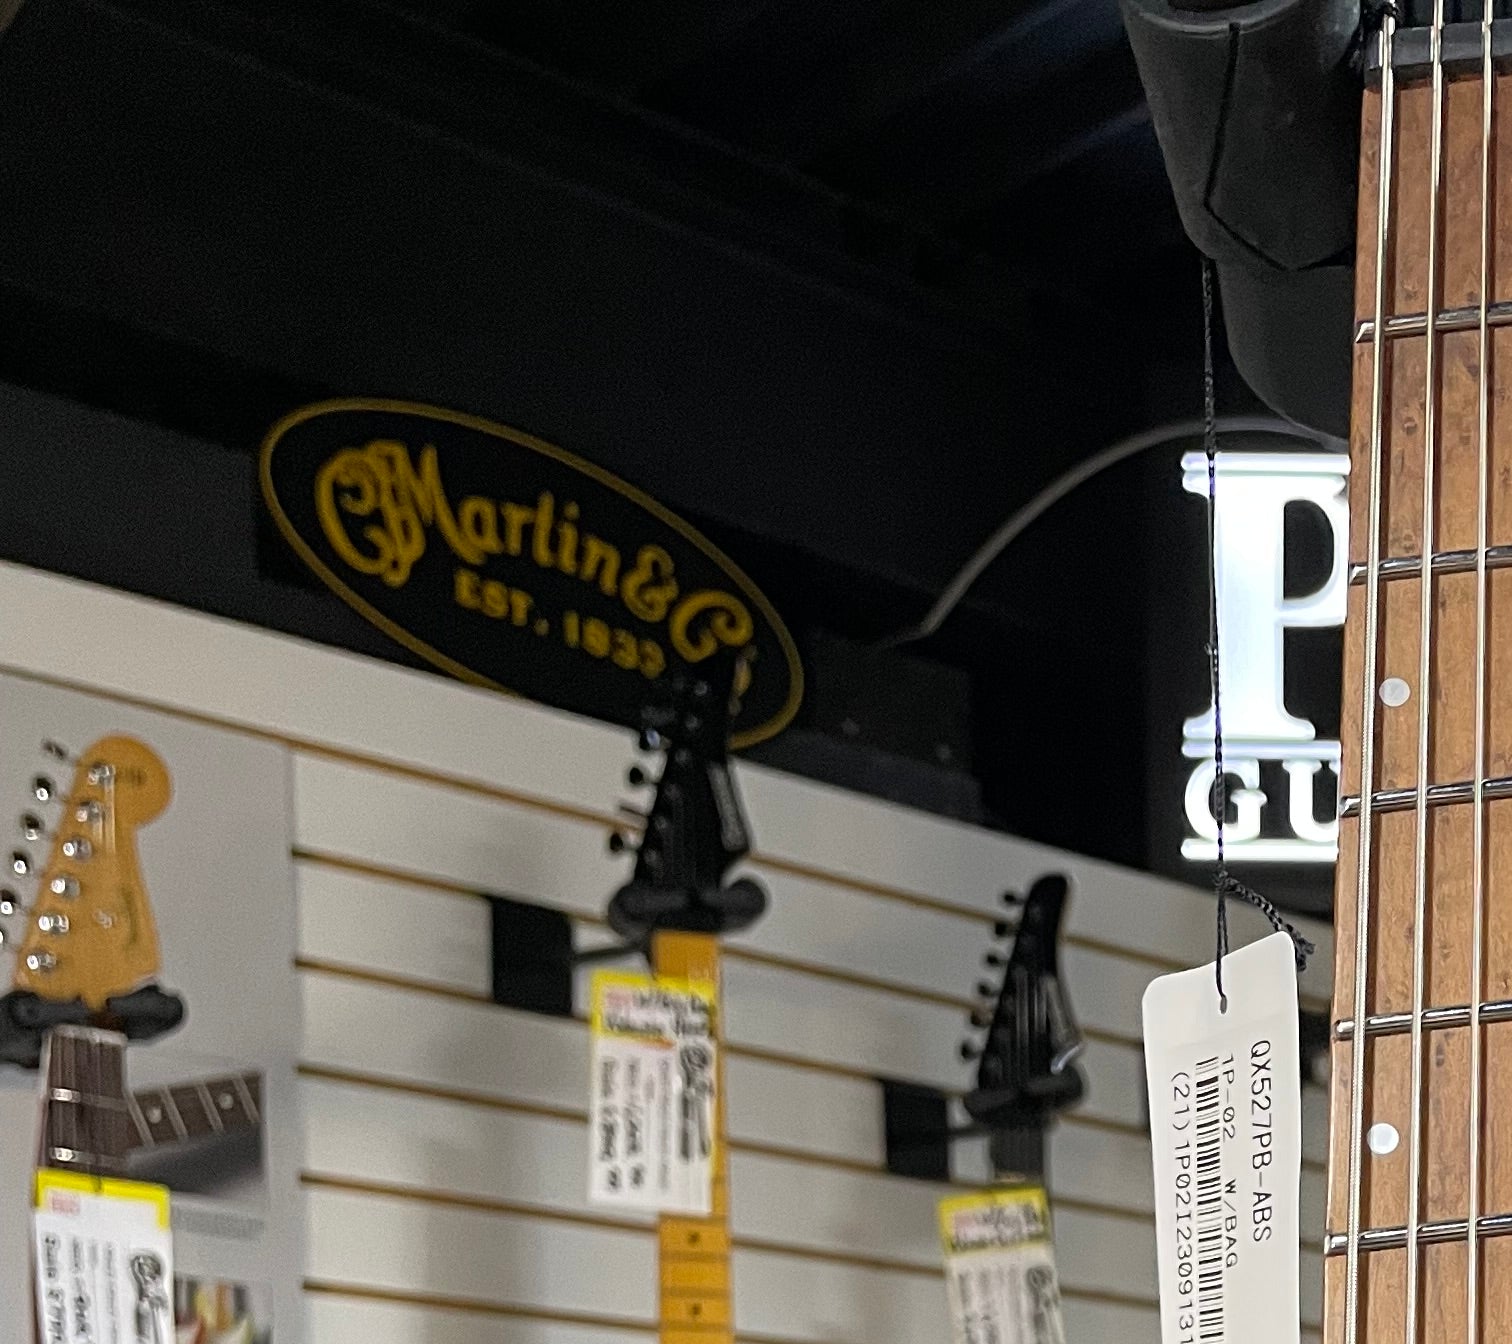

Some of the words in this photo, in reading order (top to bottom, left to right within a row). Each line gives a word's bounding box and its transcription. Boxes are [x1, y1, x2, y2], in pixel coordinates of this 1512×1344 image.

[1221, 1053, 1236, 1144] 1P-02
[1249, 1039, 1273, 1243] QX527PB-ABS
[1223, 1178, 1238, 1269] W/BAG
